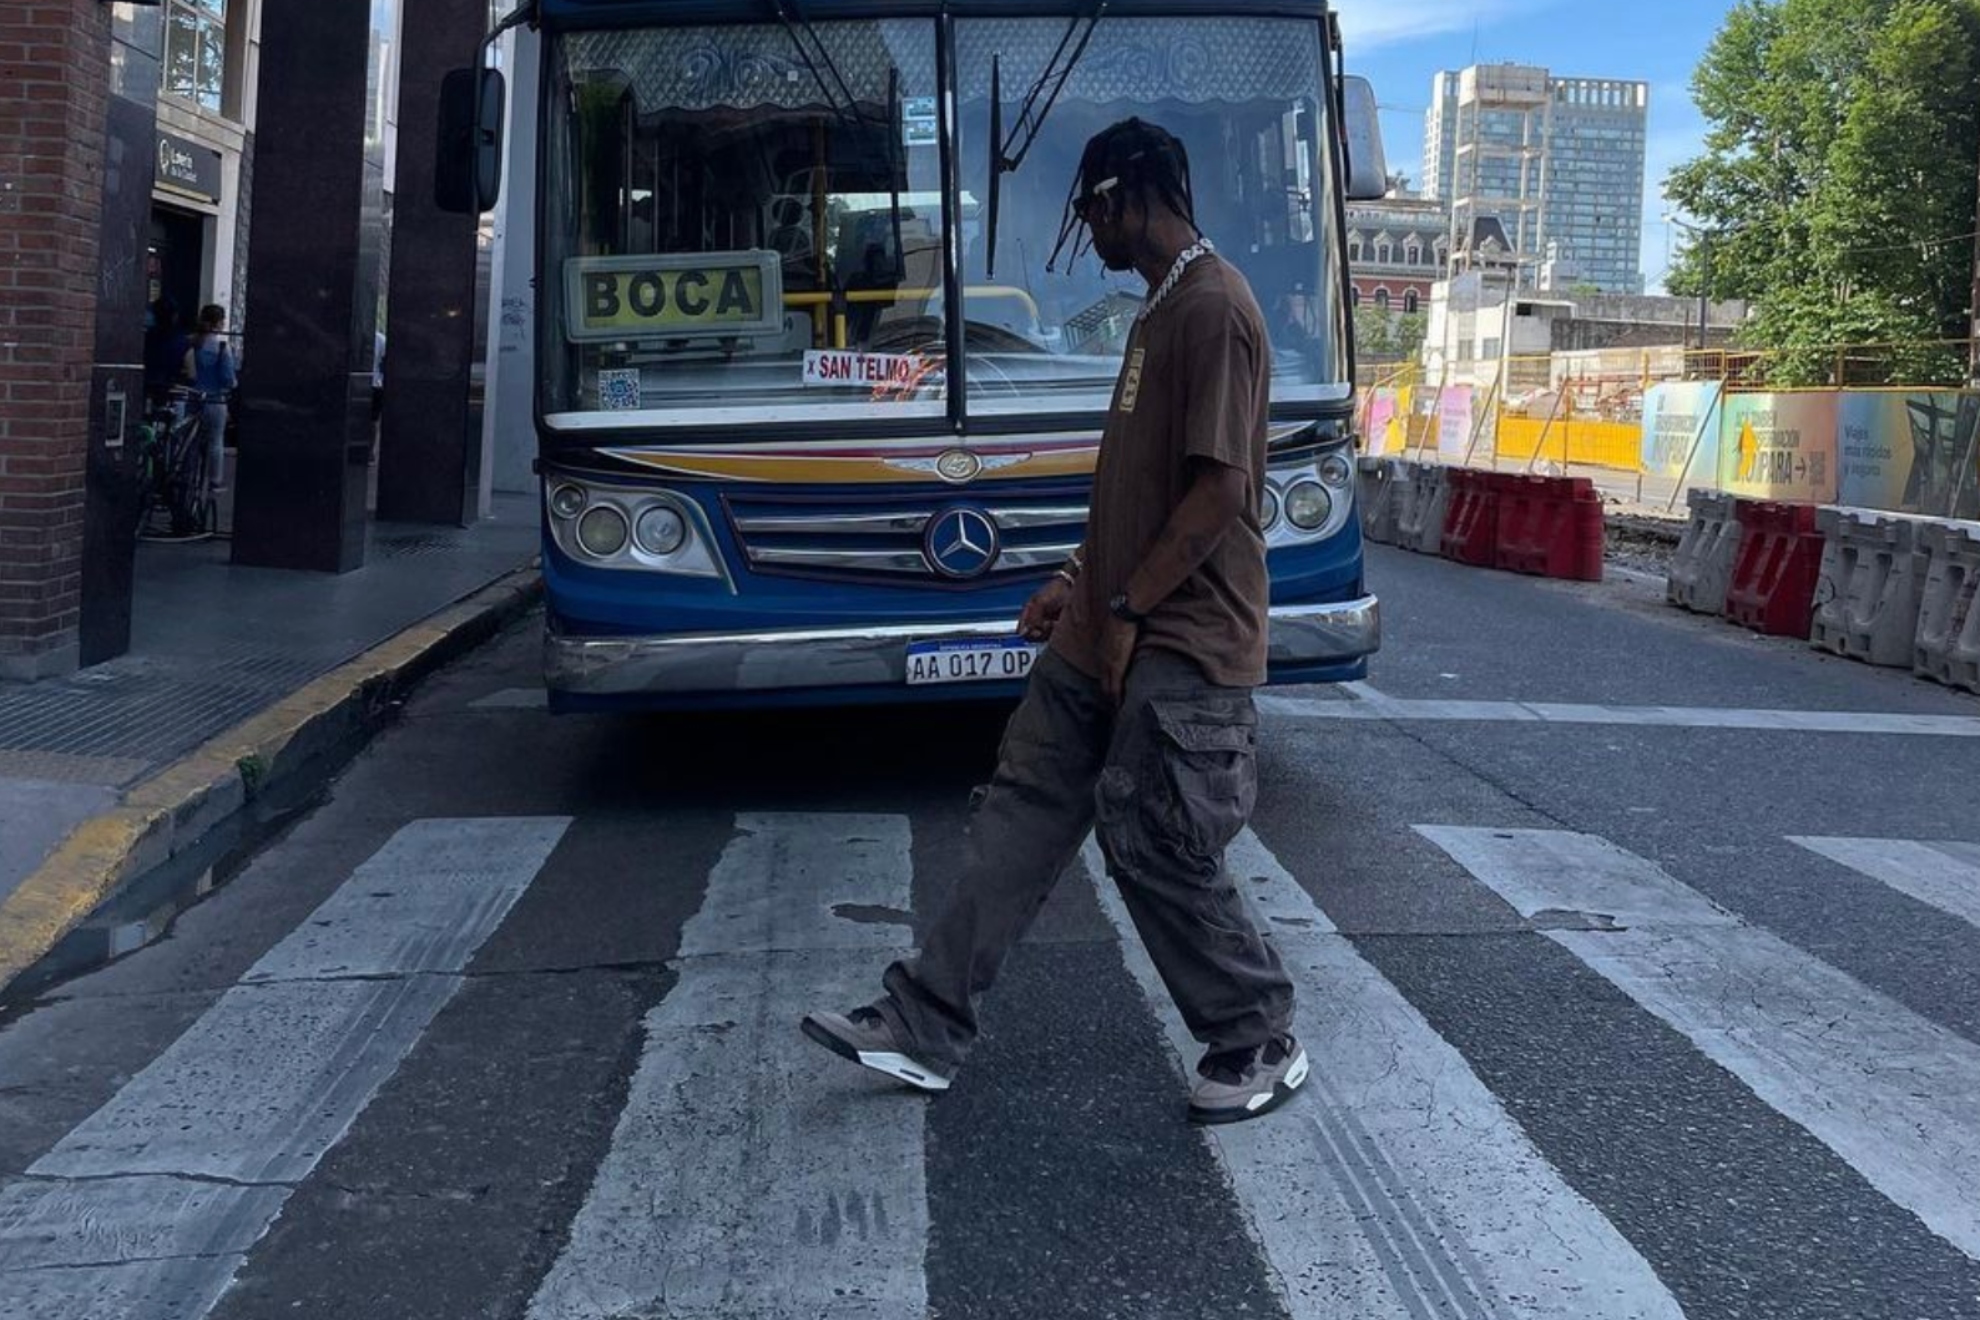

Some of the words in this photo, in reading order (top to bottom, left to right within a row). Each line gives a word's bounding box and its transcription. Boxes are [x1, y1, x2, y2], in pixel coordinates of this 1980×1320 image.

[586, 270, 754, 318] BOCA
[819, 354, 851, 379] SAN
[856, 355, 909, 382] TELMO
[913, 655, 940, 680] AA
[949, 652, 992, 677] 017
[1002, 650, 1031, 675] OP
